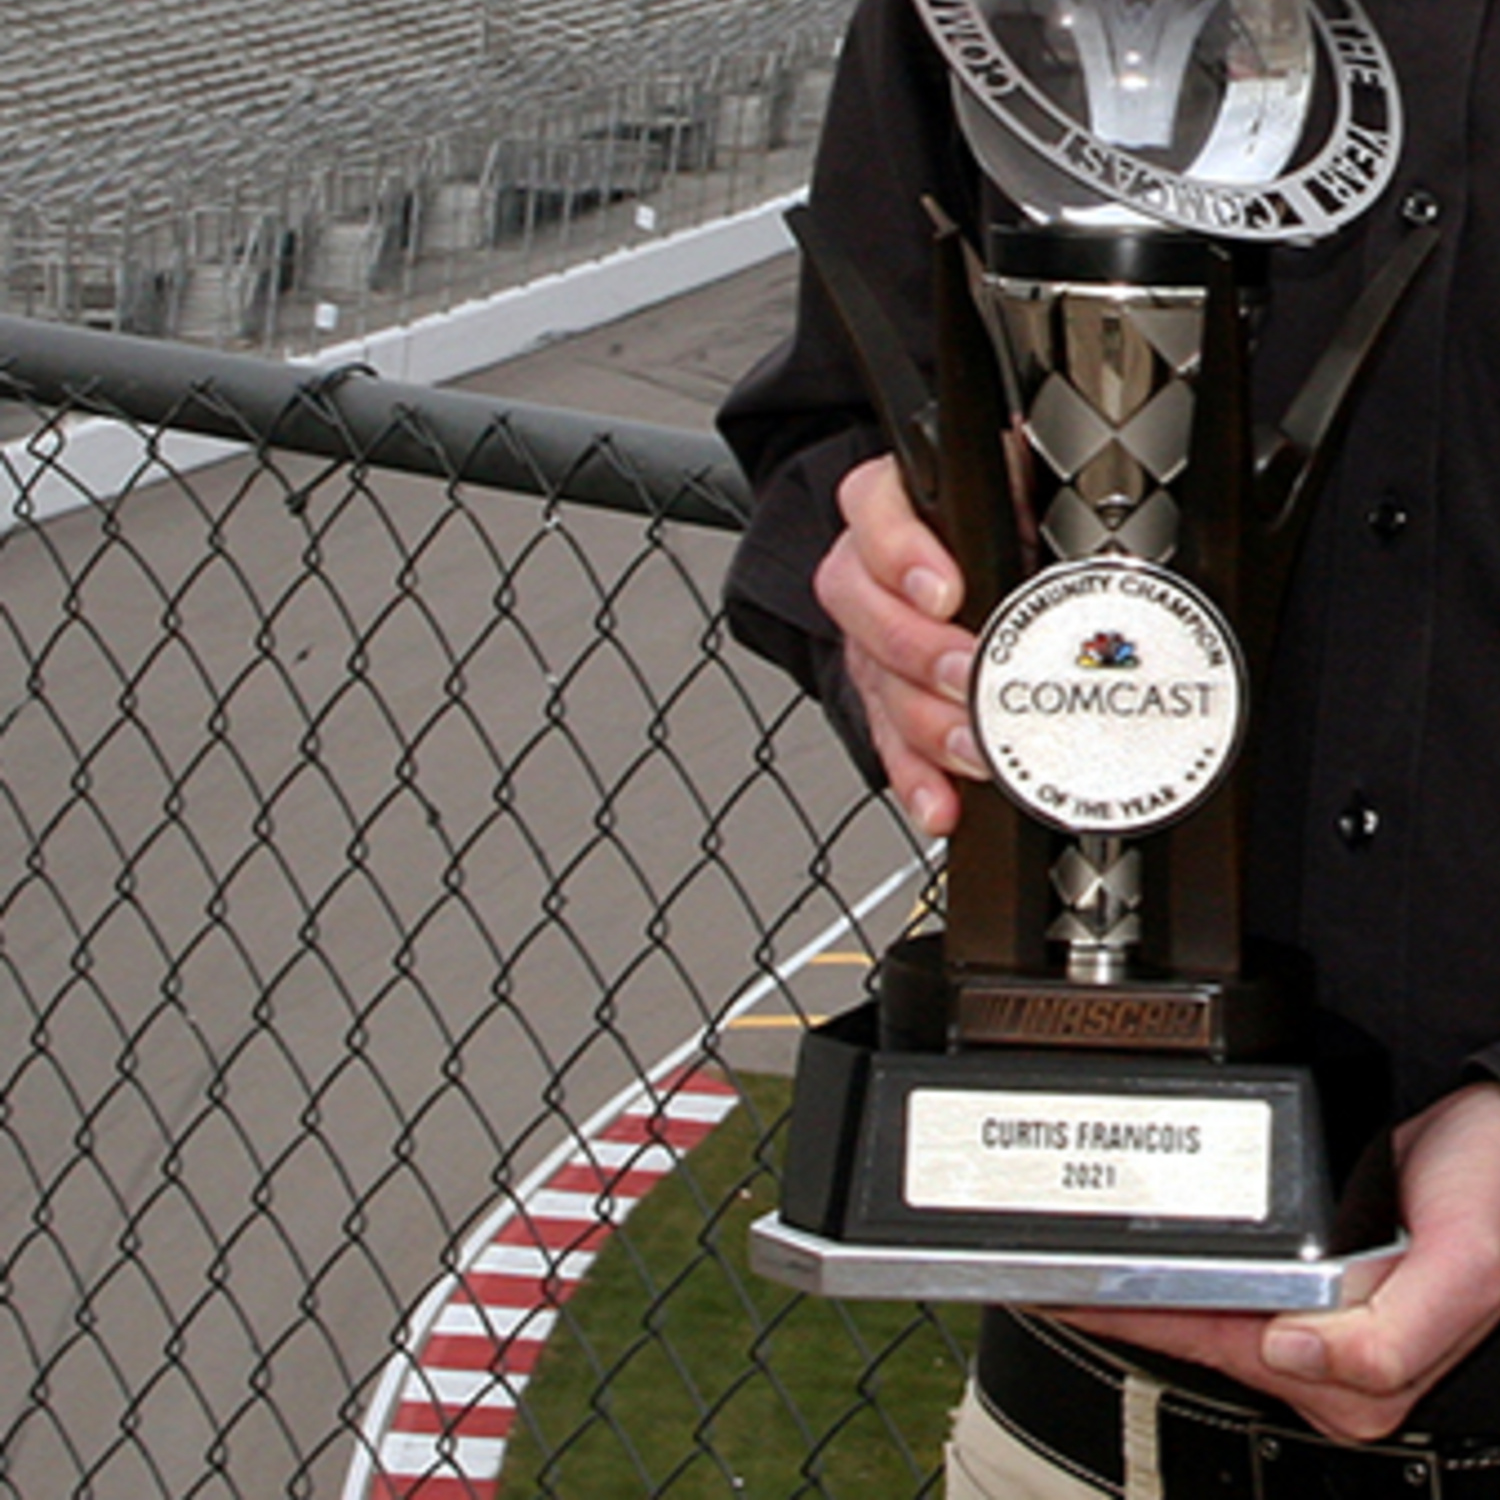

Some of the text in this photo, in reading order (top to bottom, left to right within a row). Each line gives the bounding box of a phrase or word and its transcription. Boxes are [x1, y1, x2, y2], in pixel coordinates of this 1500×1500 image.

[1328, 18, 1384, 89] THE
[1056, 128, 1280, 228] COMCAST
[1322, 125, 1390, 203] YEAR
[990, 575, 1227, 668] COMMUNITY CHAMPION
[998, 680, 1214, 718] COMCAST
[1036, 784, 1177, 819] OF THE YEAR
[1020, 995, 1196, 1038] NASCAR
[981, 1116, 1202, 1155] CURTIS FRANCOIS
[1062, 1163, 1116, 1189] 2021
